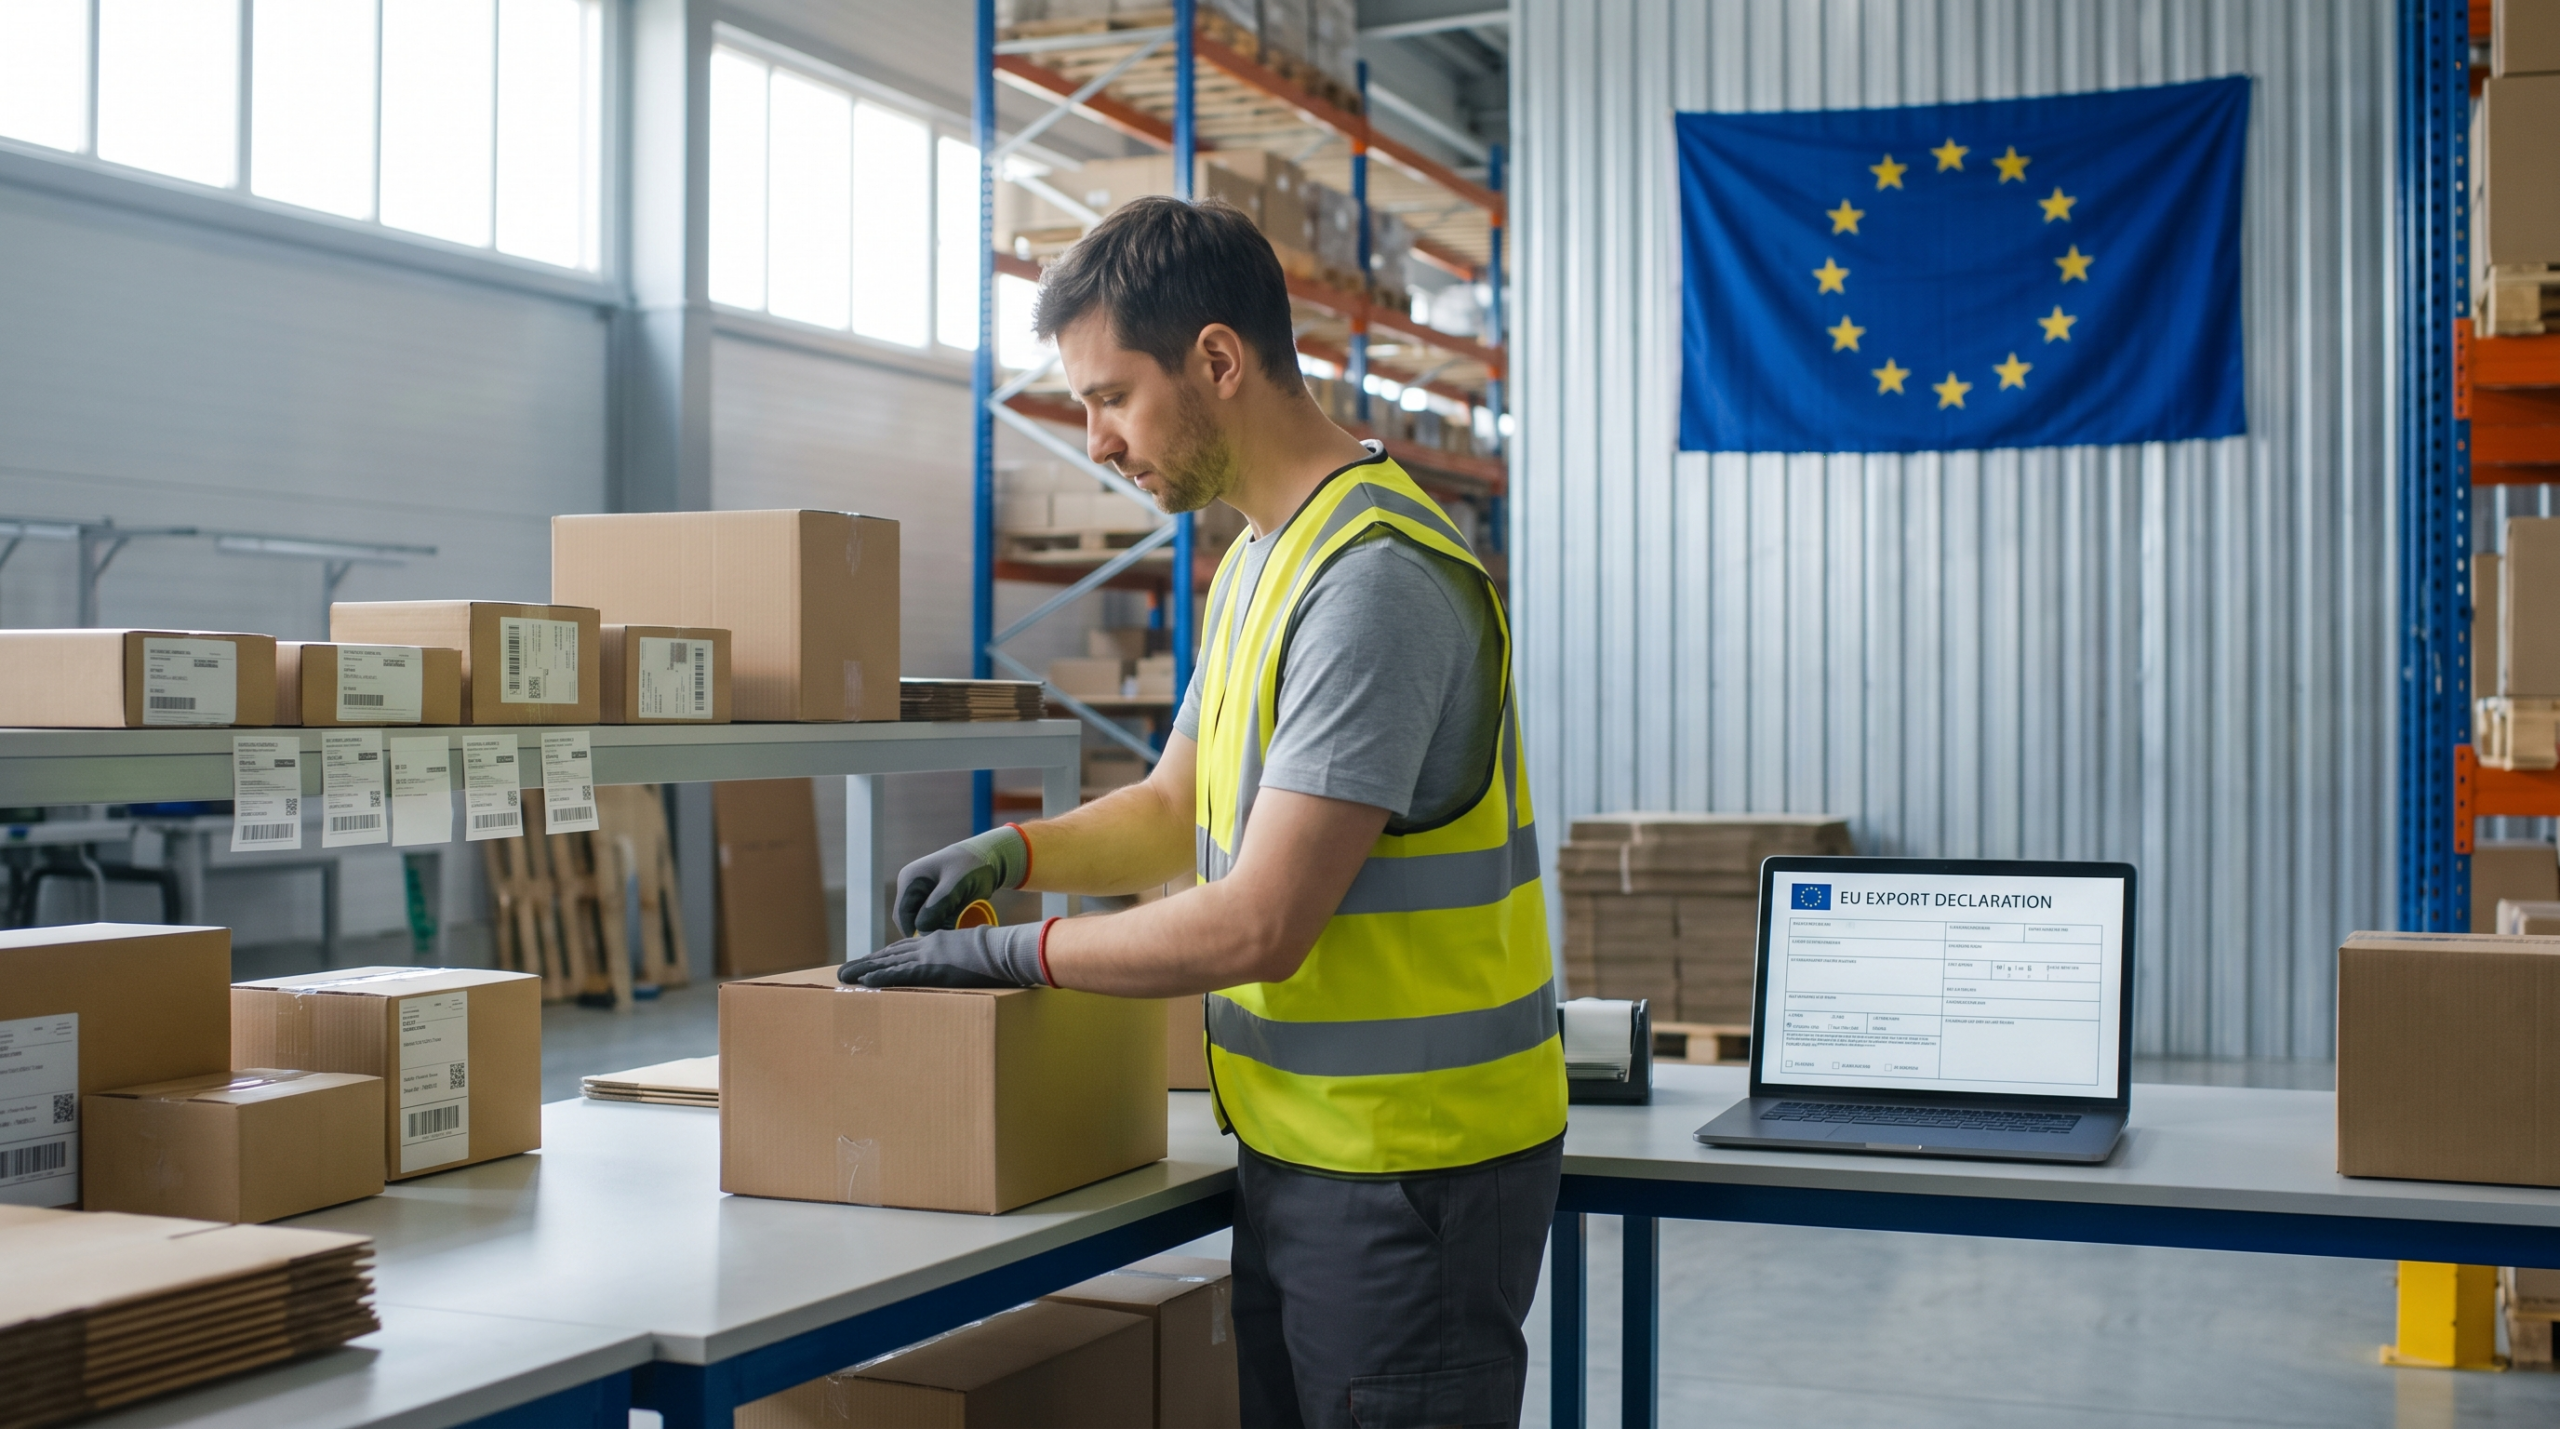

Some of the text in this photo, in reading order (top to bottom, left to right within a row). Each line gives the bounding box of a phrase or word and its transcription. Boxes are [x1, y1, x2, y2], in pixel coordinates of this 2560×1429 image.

[1840, 891, 2052, 909] EU EXPORT DECLARATION
